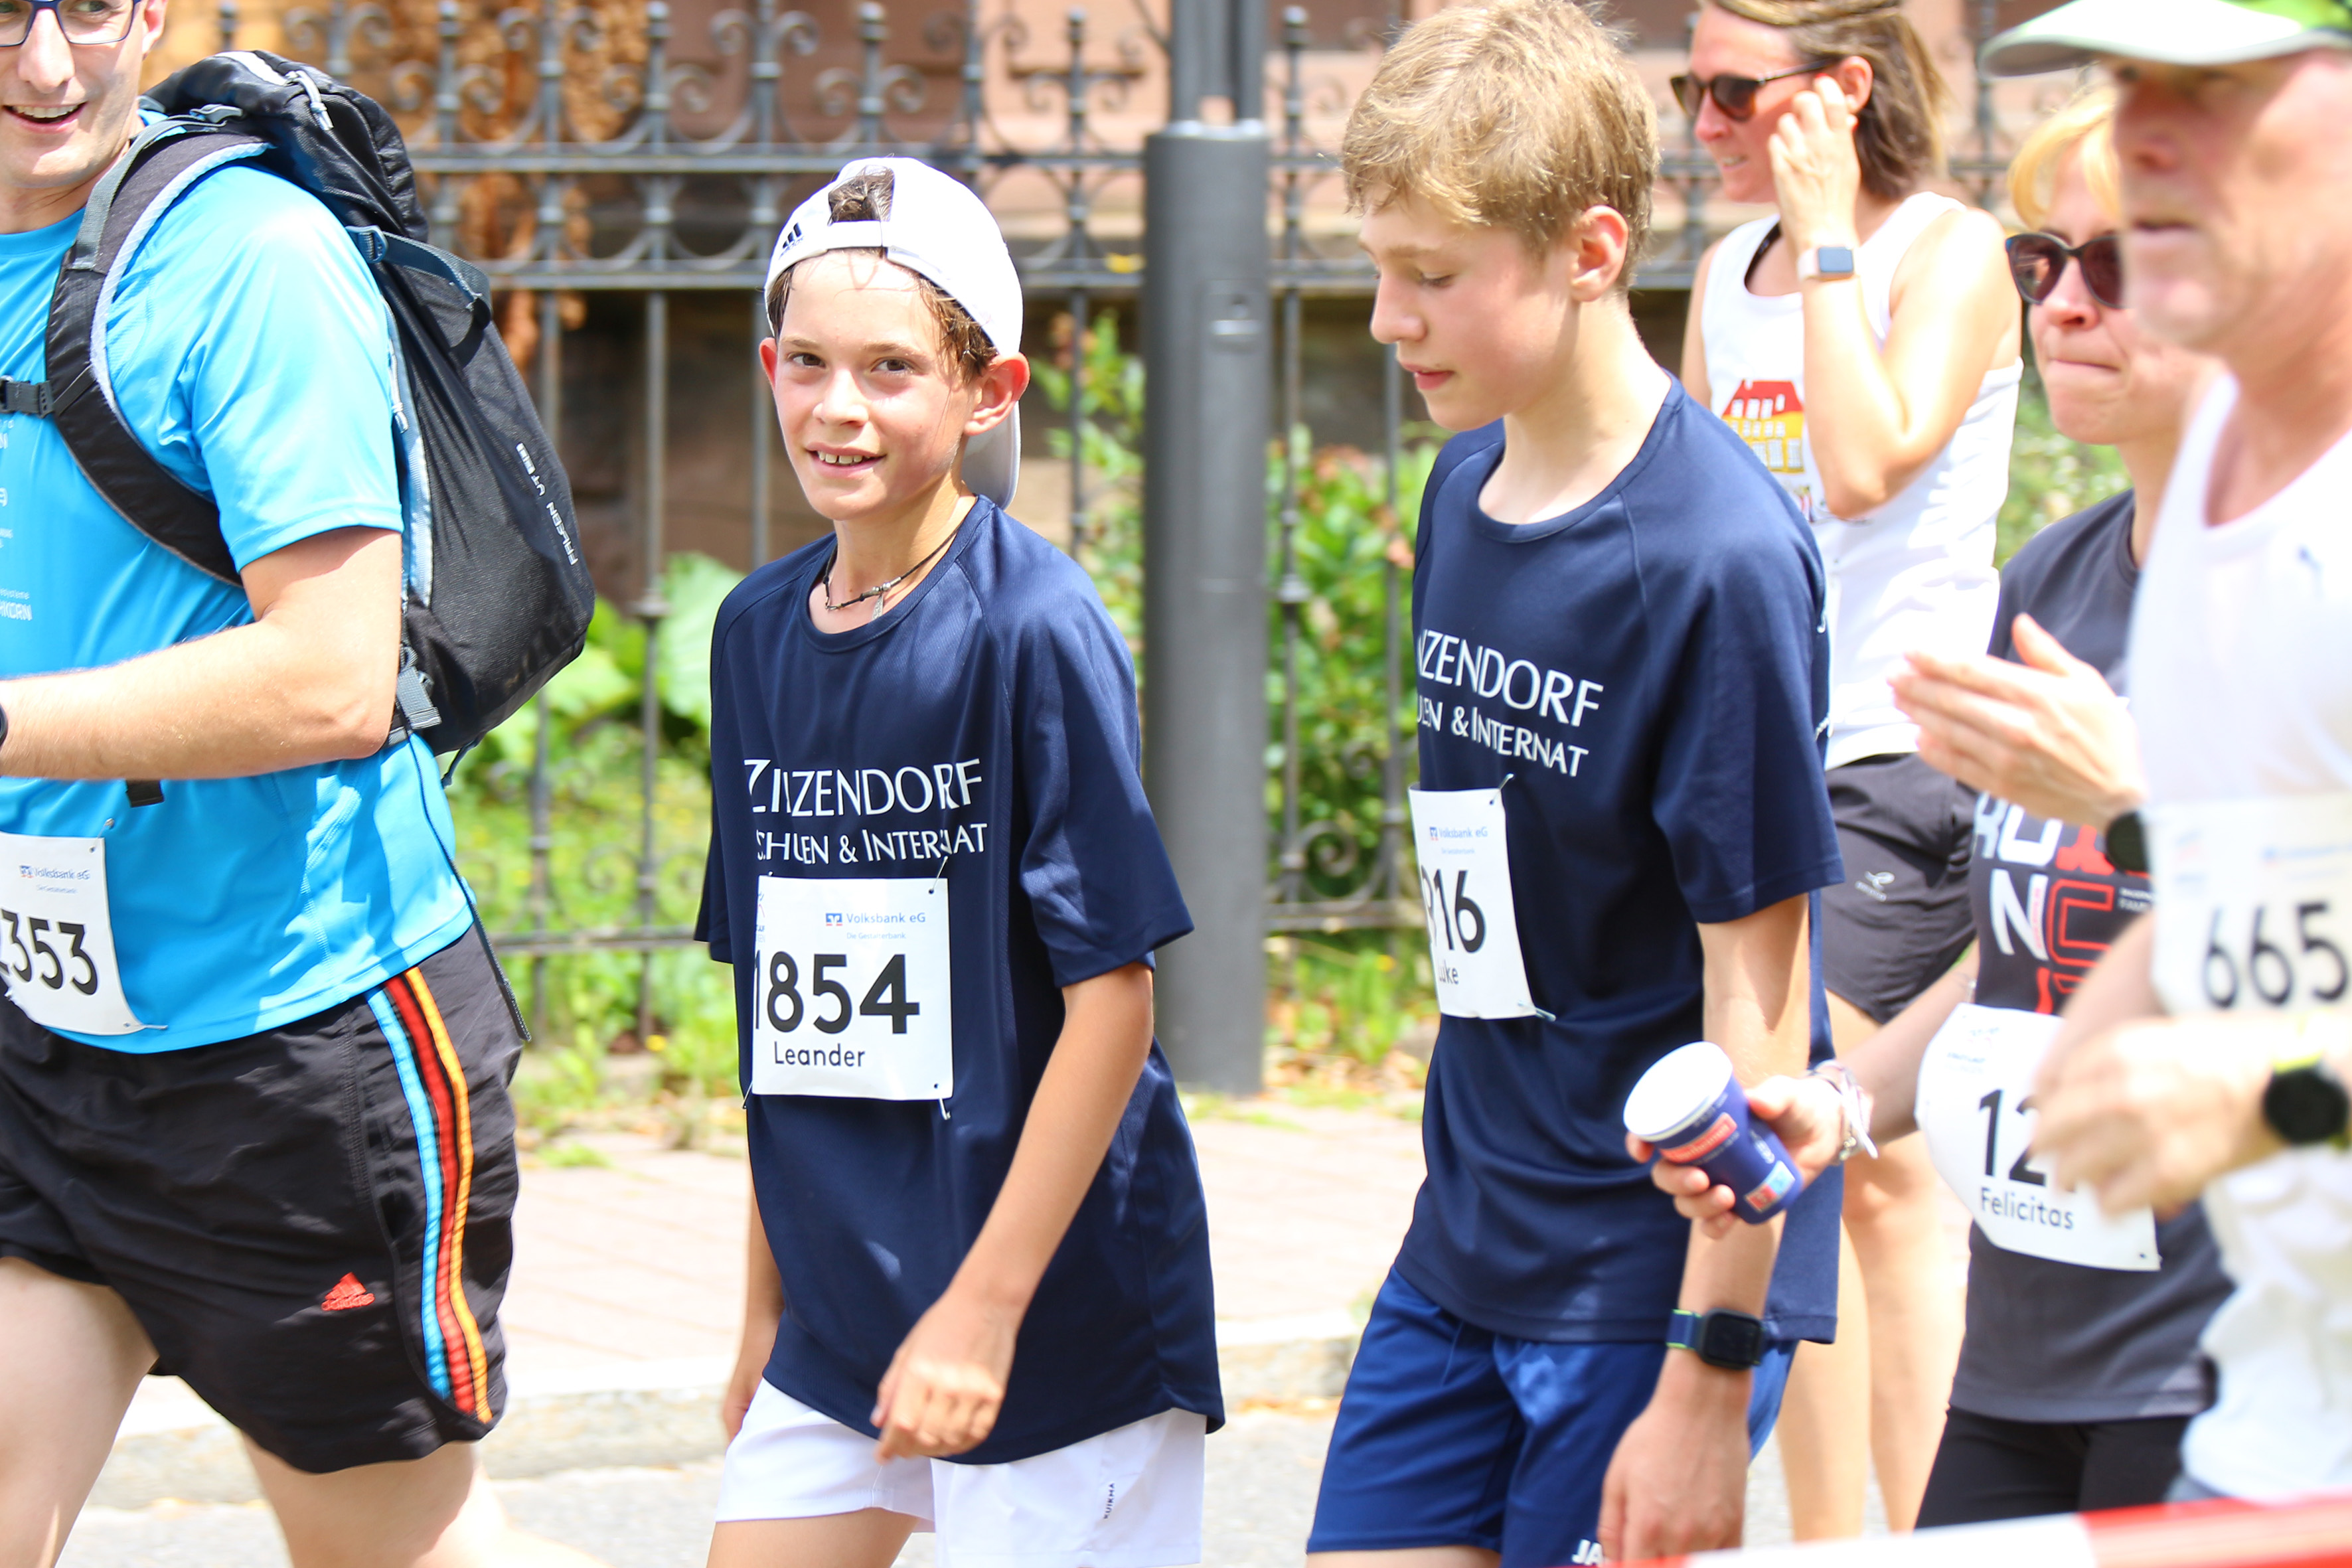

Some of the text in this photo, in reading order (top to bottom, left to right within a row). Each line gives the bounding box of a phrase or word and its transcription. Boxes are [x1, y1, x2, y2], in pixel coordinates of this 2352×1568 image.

[546, 502, 578, 565] FALCON
[1451, 706, 1469, 738] &
[1471, 706, 1589, 777] INTERNAT
[839, 834, 858, 864] &
[1475, 826, 1488, 837] eG
[846, 912, 926, 923] Volksbank eG
[0, 908, 99, 996] 353
[2202, 903, 2349, 1008] 665
[774, 1041, 866, 1067] Leander
[1981, 1186, 2074, 1229] Felicitas
